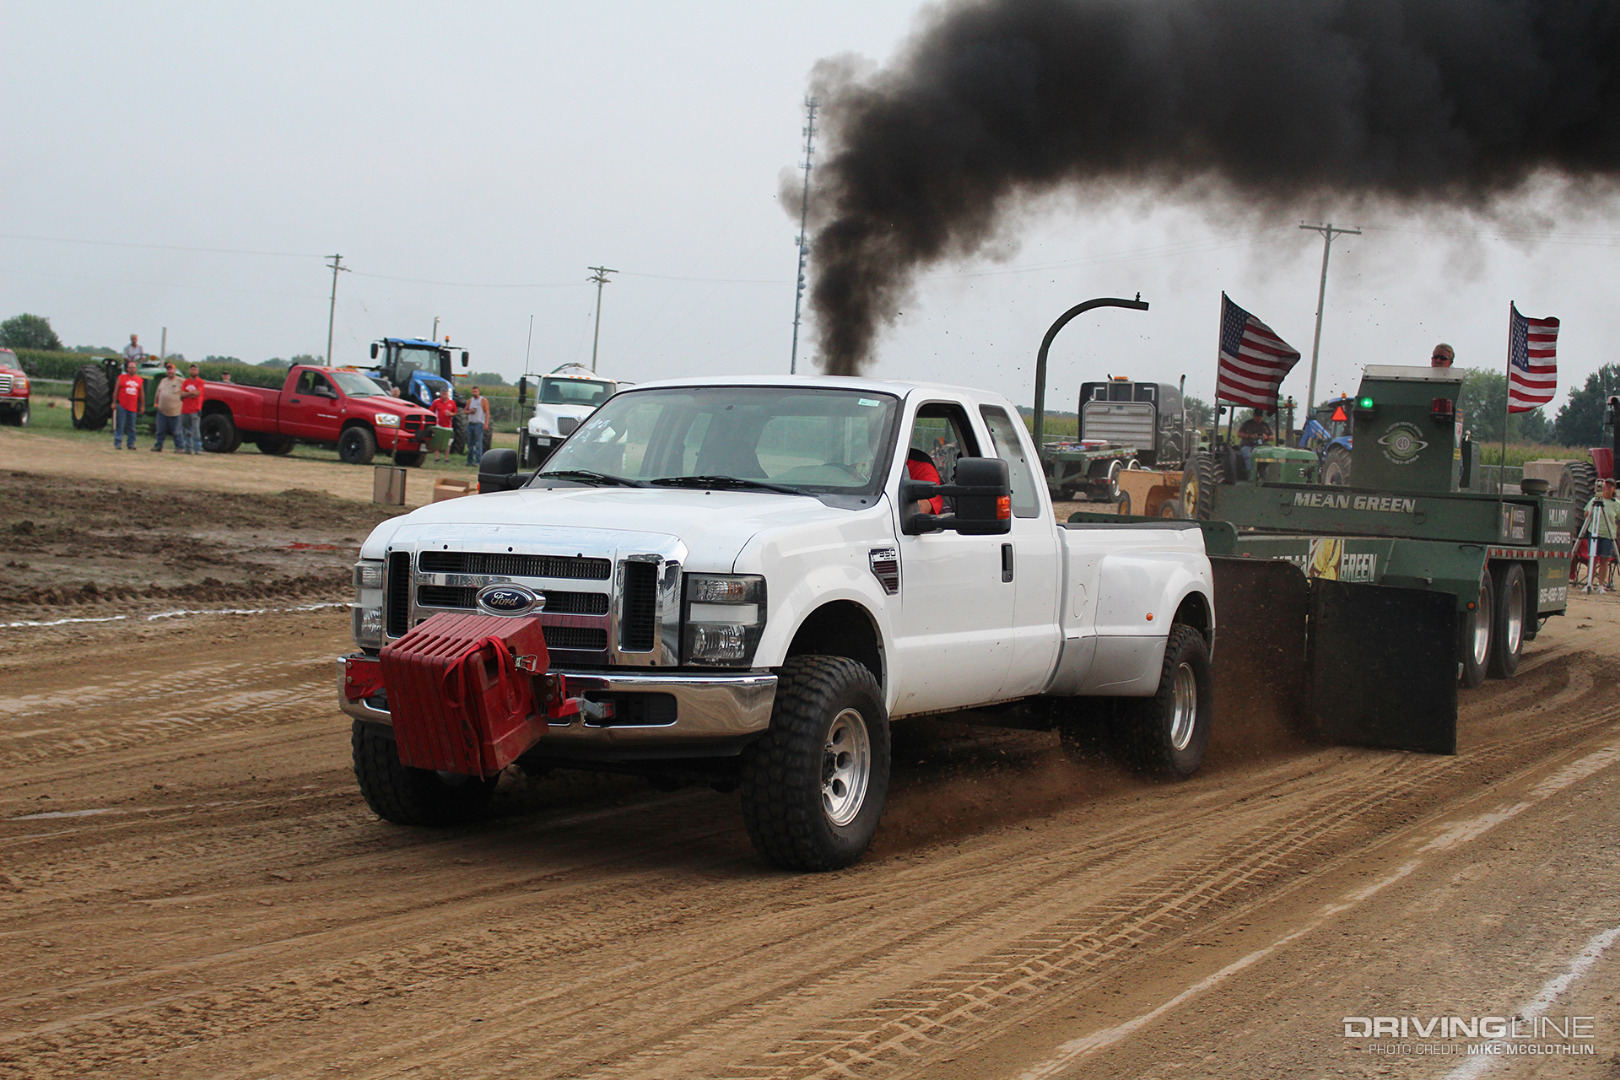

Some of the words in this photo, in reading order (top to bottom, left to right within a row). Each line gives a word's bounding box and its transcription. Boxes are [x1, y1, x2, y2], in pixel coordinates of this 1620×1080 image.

[1293, 492, 1350, 509] MEAN
[1353, 496, 1416, 513] GREEN
[1340, 553, 1378, 583] GREEN
[490, 592, 520, 607] Ford
